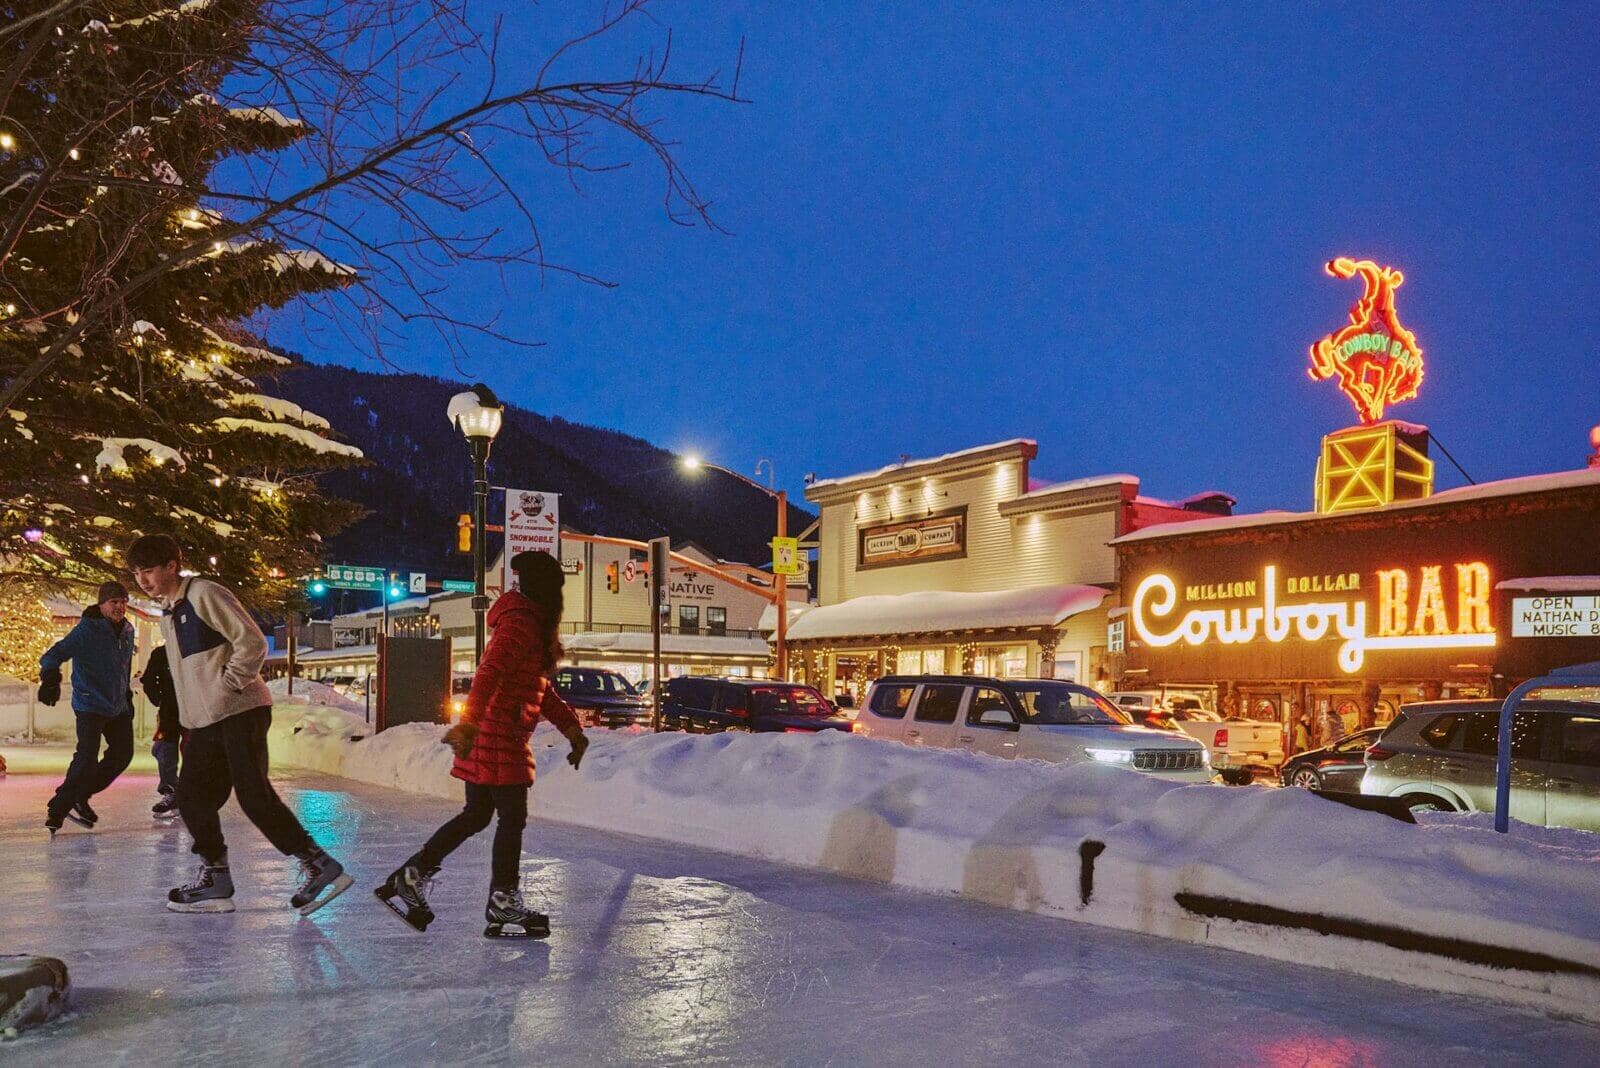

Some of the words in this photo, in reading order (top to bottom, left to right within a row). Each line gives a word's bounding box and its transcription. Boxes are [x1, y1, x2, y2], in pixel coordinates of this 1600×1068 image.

[1334, 333, 1390, 362] COWBOY
[1390, 341, 1417, 372] BAR
[509, 534, 554, 543] SNOWMOBILE
[870, 540, 893, 548] JACKSON
[924, 531, 951, 540] COMPANY
[512, 545, 525, 553] HILL
[669, 582, 715, 595] NATIVE
[1186, 580, 1256, 601] MILLION
[1287, 573, 1360, 593] DOLLAR
[1532, 598, 1572, 609] OPEN
[1132, 564, 1367, 673] Cowboy
[1375, 561, 1497, 636] BAR
[1523, 611, 1582, 622] NATHAN
[1533, 624, 1577, 634] MUSIC
